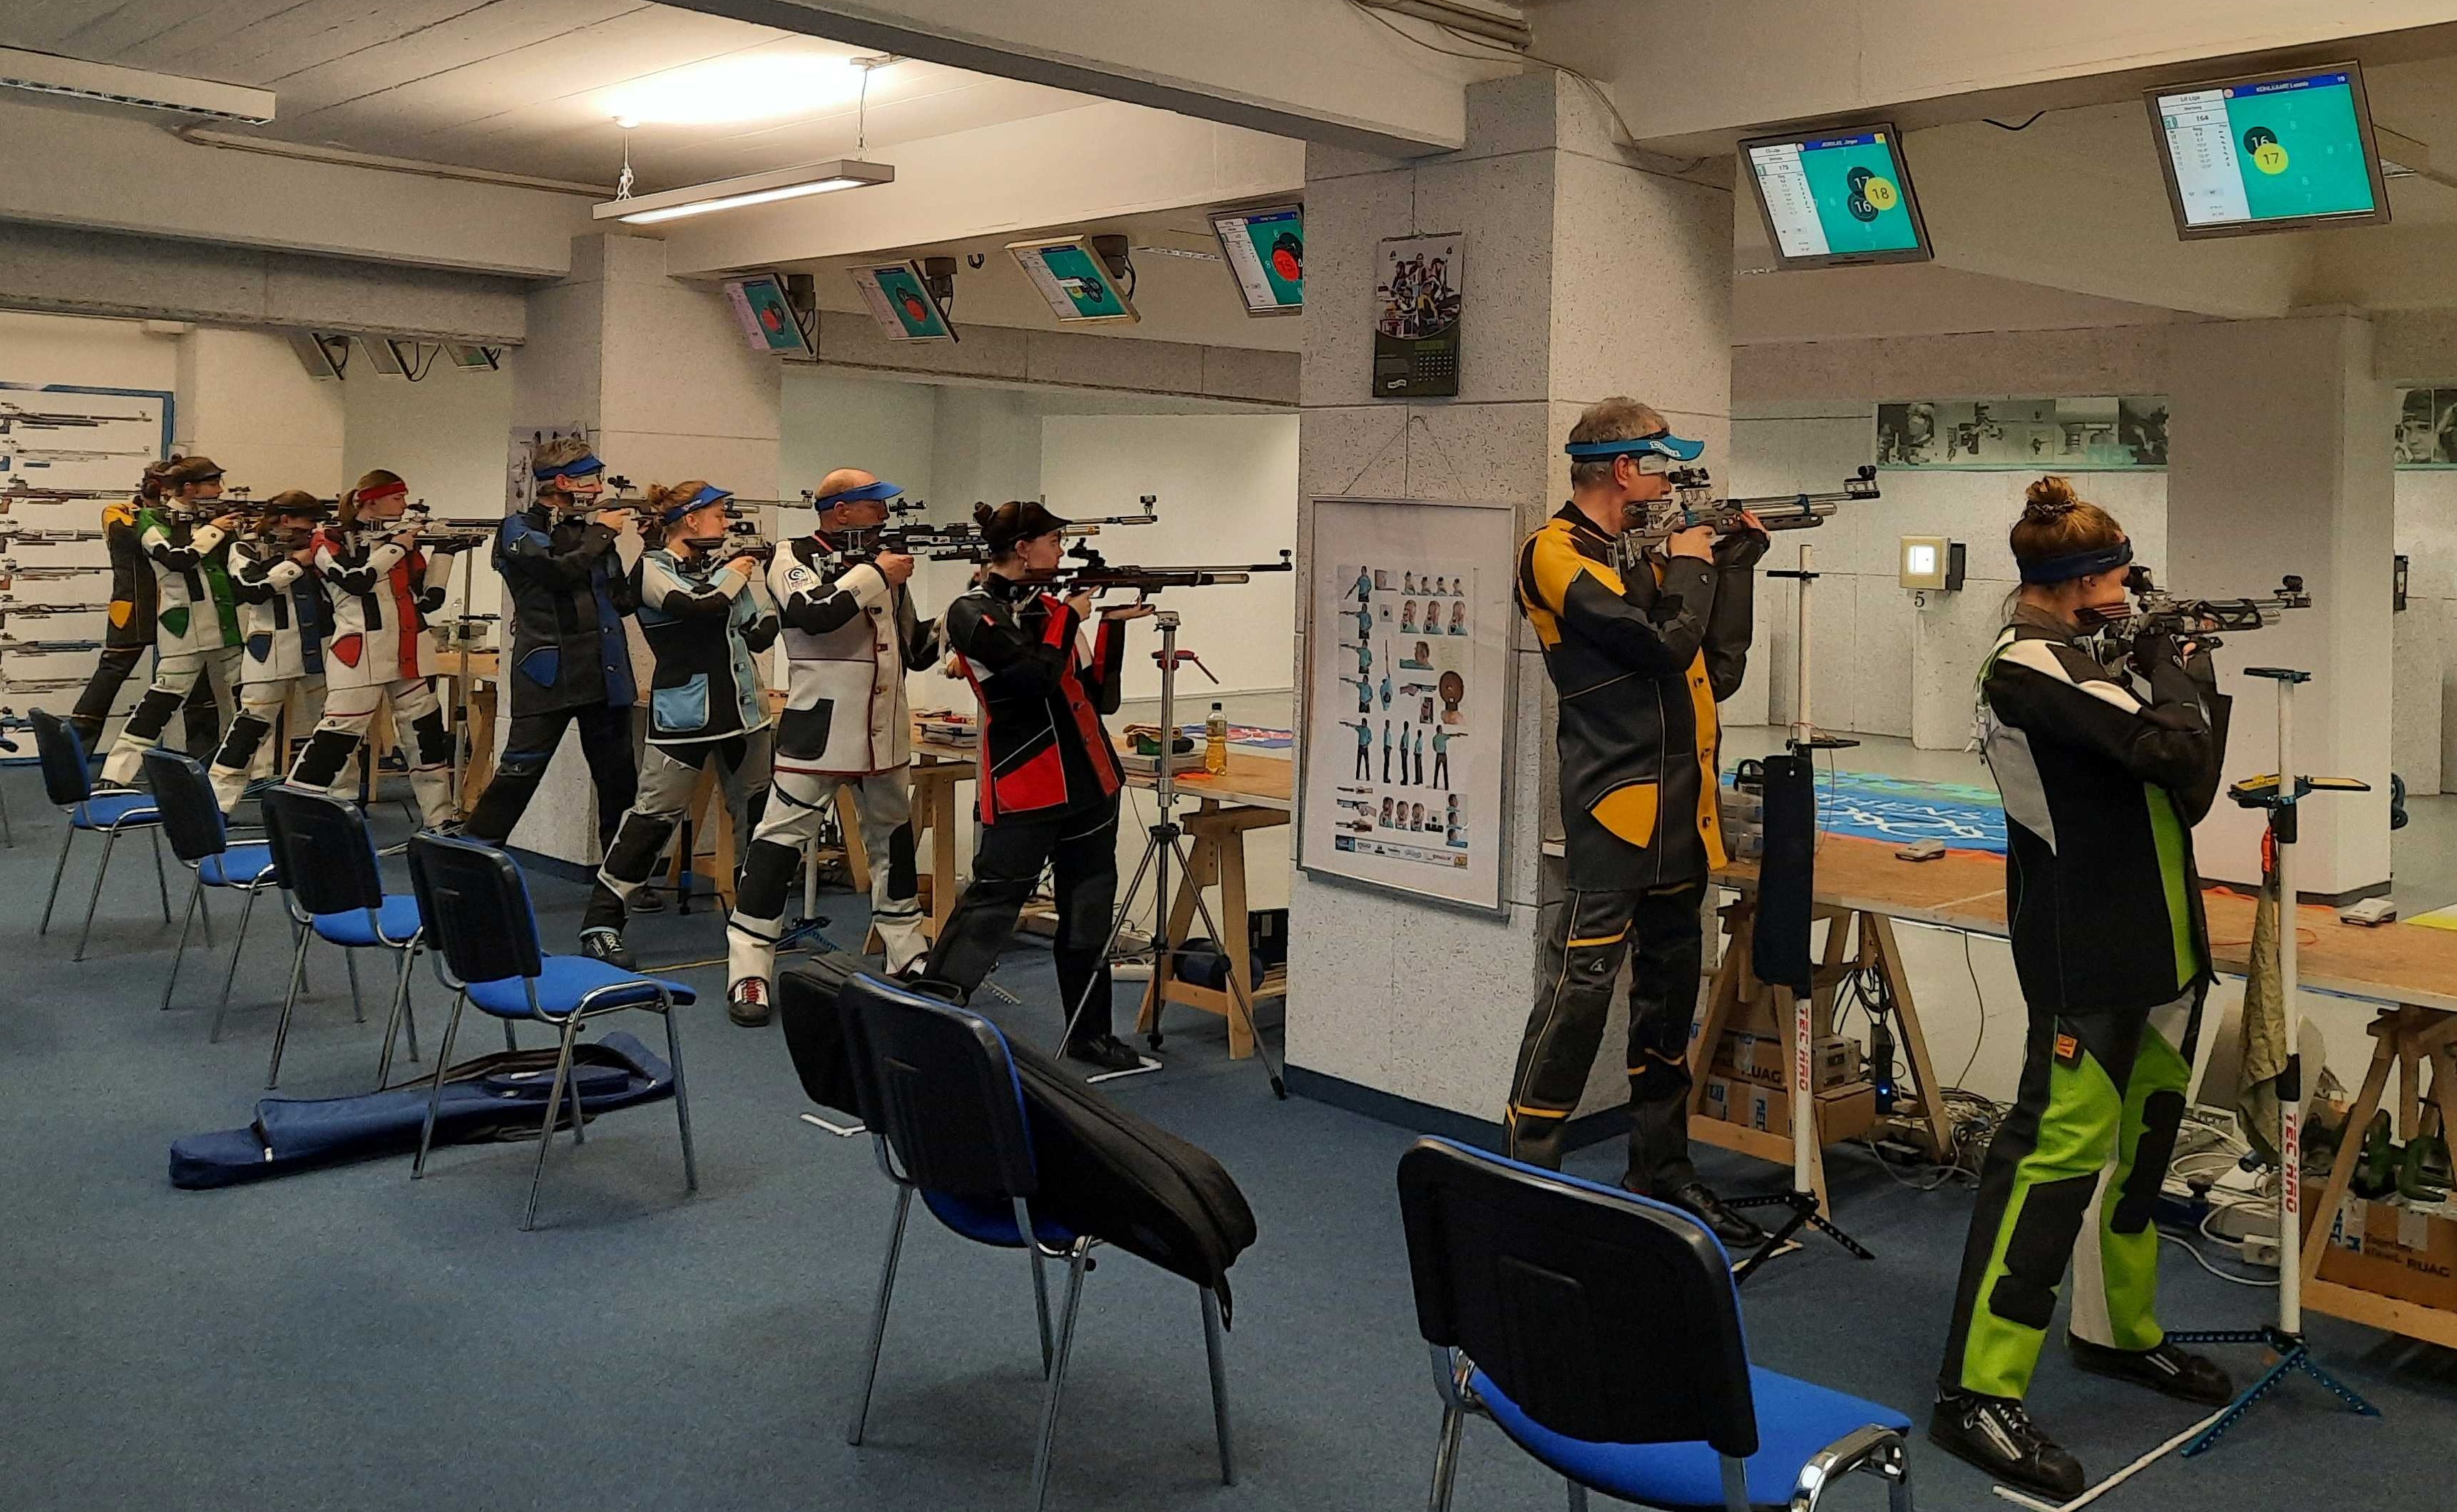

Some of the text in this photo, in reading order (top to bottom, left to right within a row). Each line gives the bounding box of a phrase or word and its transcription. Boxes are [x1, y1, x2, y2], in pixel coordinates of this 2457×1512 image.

[2262, 152, 2279, 165] 17
[1854, 176, 1869, 190] 17
[1872, 187, 1889, 200] 18
[1854, 200, 1872, 213] 16
[1914, 590, 1925, 608] 5
[1741, 1065, 1781, 1084] UAG
[2406, 1258, 2451, 1278] RUAG
